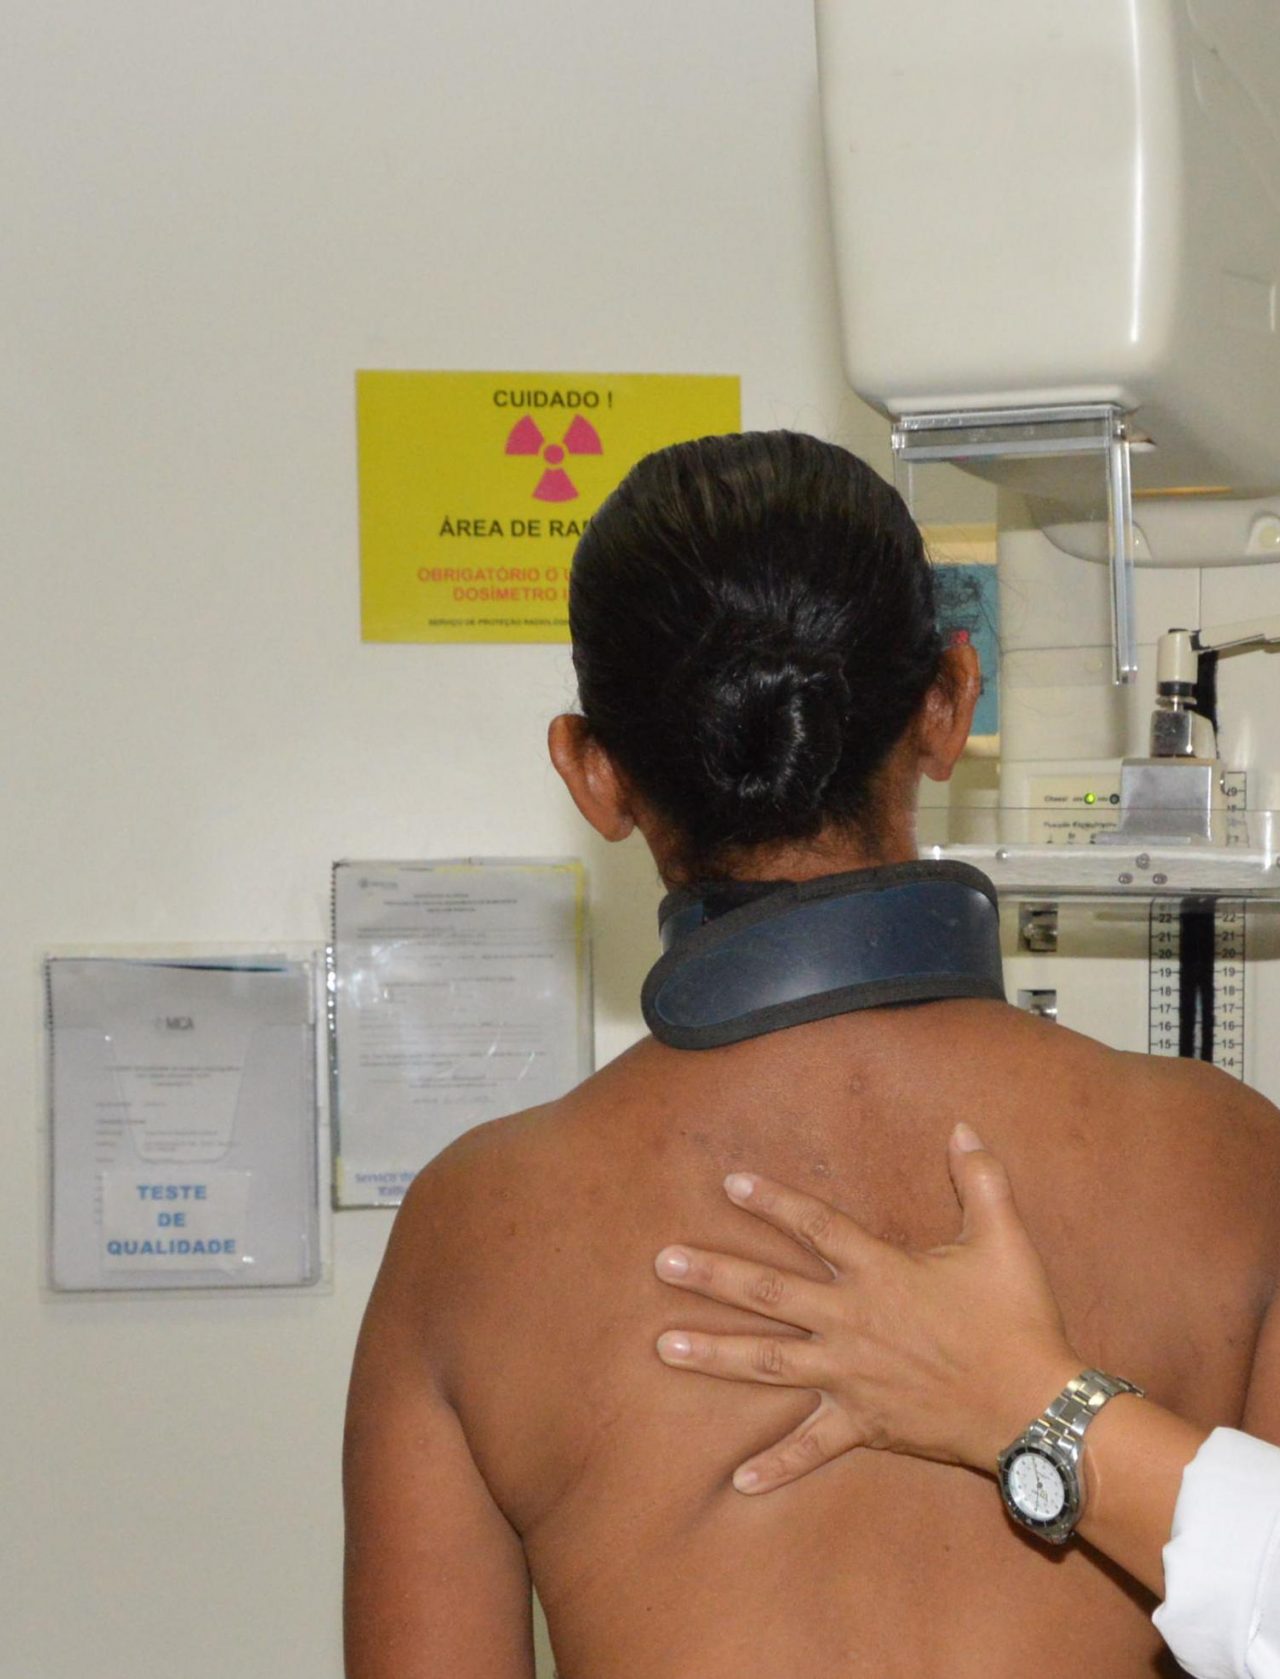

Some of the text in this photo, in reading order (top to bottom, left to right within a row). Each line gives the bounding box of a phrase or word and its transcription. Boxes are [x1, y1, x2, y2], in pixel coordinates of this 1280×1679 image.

[493, 390, 613, 408] CUIDADO !
[439, 515, 504, 537] ÁREA
[511, 519, 541, 537] DE
[417, 566, 540, 582] OBRIGATÓRIO
[453, 585, 556, 601] DOSÍMETRO
[1158, 914, 1172, 923] 22
[1222, 912, 1236, 923] 22
[1158, 932, 1172, 942] 21
[1222, 931, 1236, 941] 21
[1158, 968, 1172, 978] 19
[1222, 967, 1236, 977] 19
[1158, 986, 1172, 996] 18
[1222, 985, 1236, 995] 18
[1158, 1004, 1172, 1014] 17
[1222, 1003, 1236, 1013] 17
[1158, 1022, 1172, 1032] 16
[1222, 1021, 1236, 1031] 16
[1158, 1040, 1172, 1050] 15
[1222, 1039, 1236, 1049] 15
[1222, 1057, 1236, 1067] 14
[137, 1185, 207, 1200] TESTE
[157, 1212, 186, 1227] DE
[106, 1239, 236, 1255] QUALIDADE
